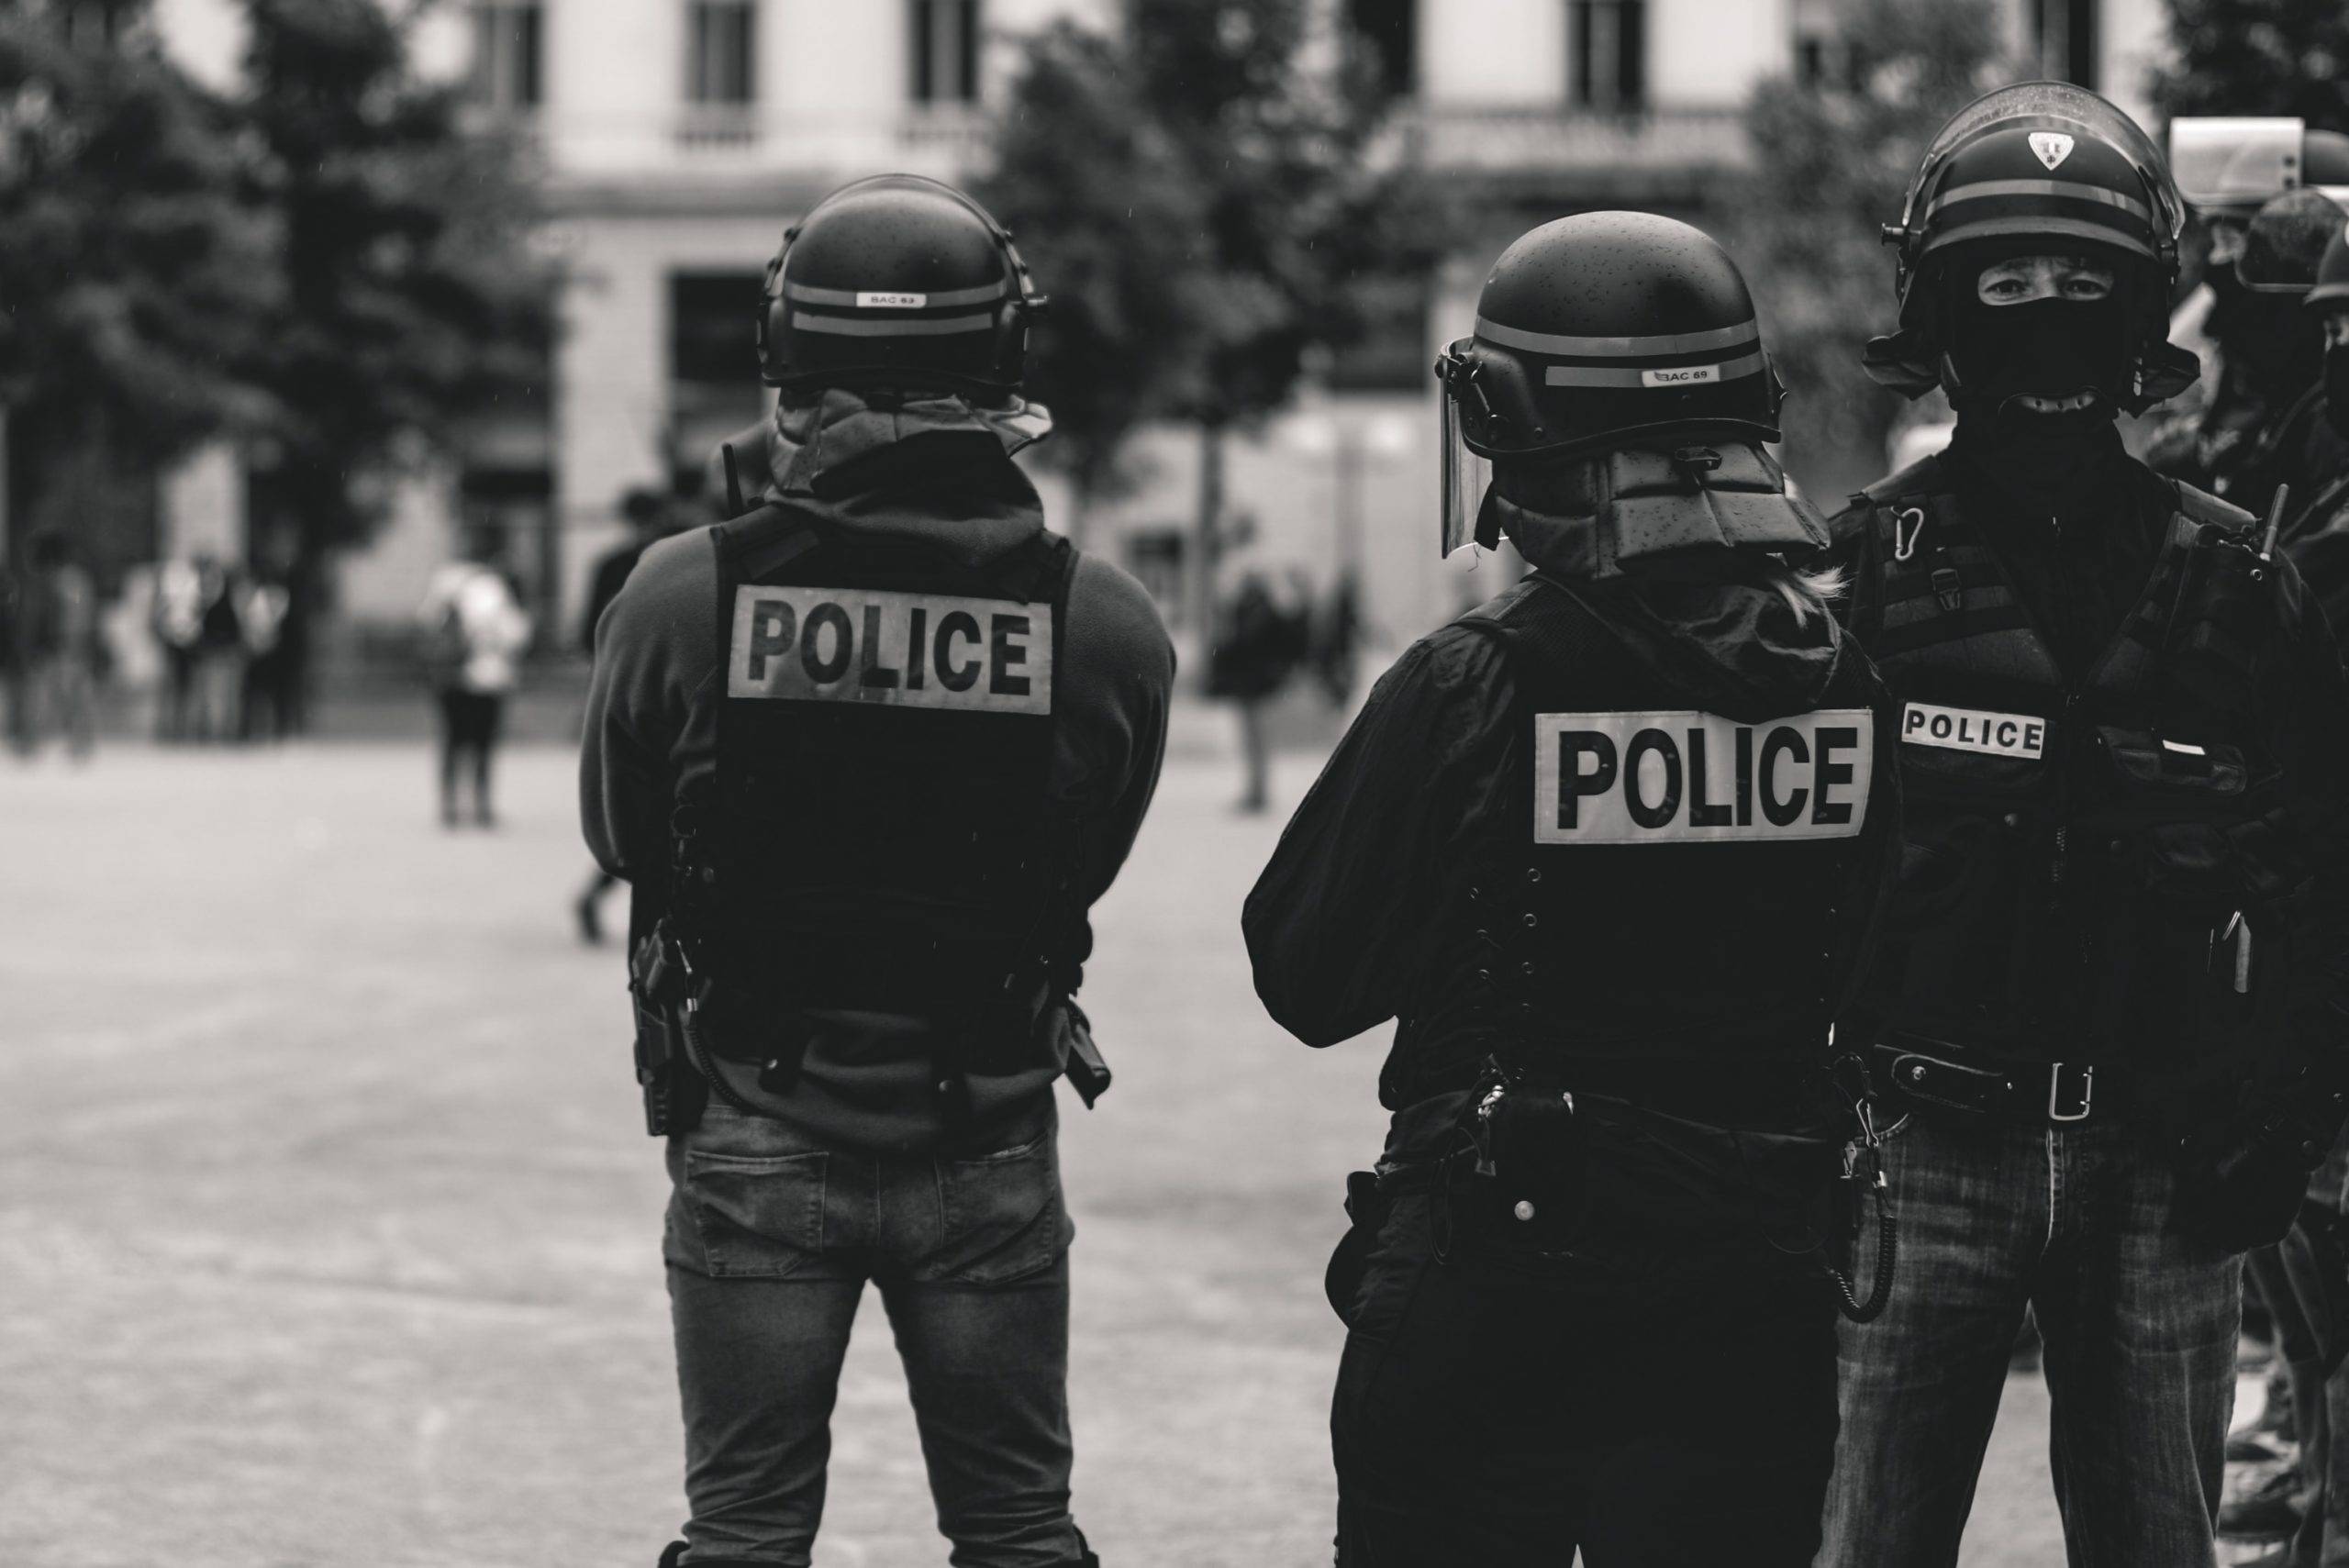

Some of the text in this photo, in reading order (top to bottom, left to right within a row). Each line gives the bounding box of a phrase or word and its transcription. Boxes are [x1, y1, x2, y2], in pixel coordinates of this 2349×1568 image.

[1693, 371, 1707, 379] 69
[748, 600, 1030, 696] POLICE
[1905, 709, 2043, 751] POLICE
[1557, 726, 1858, 828] POLICE
